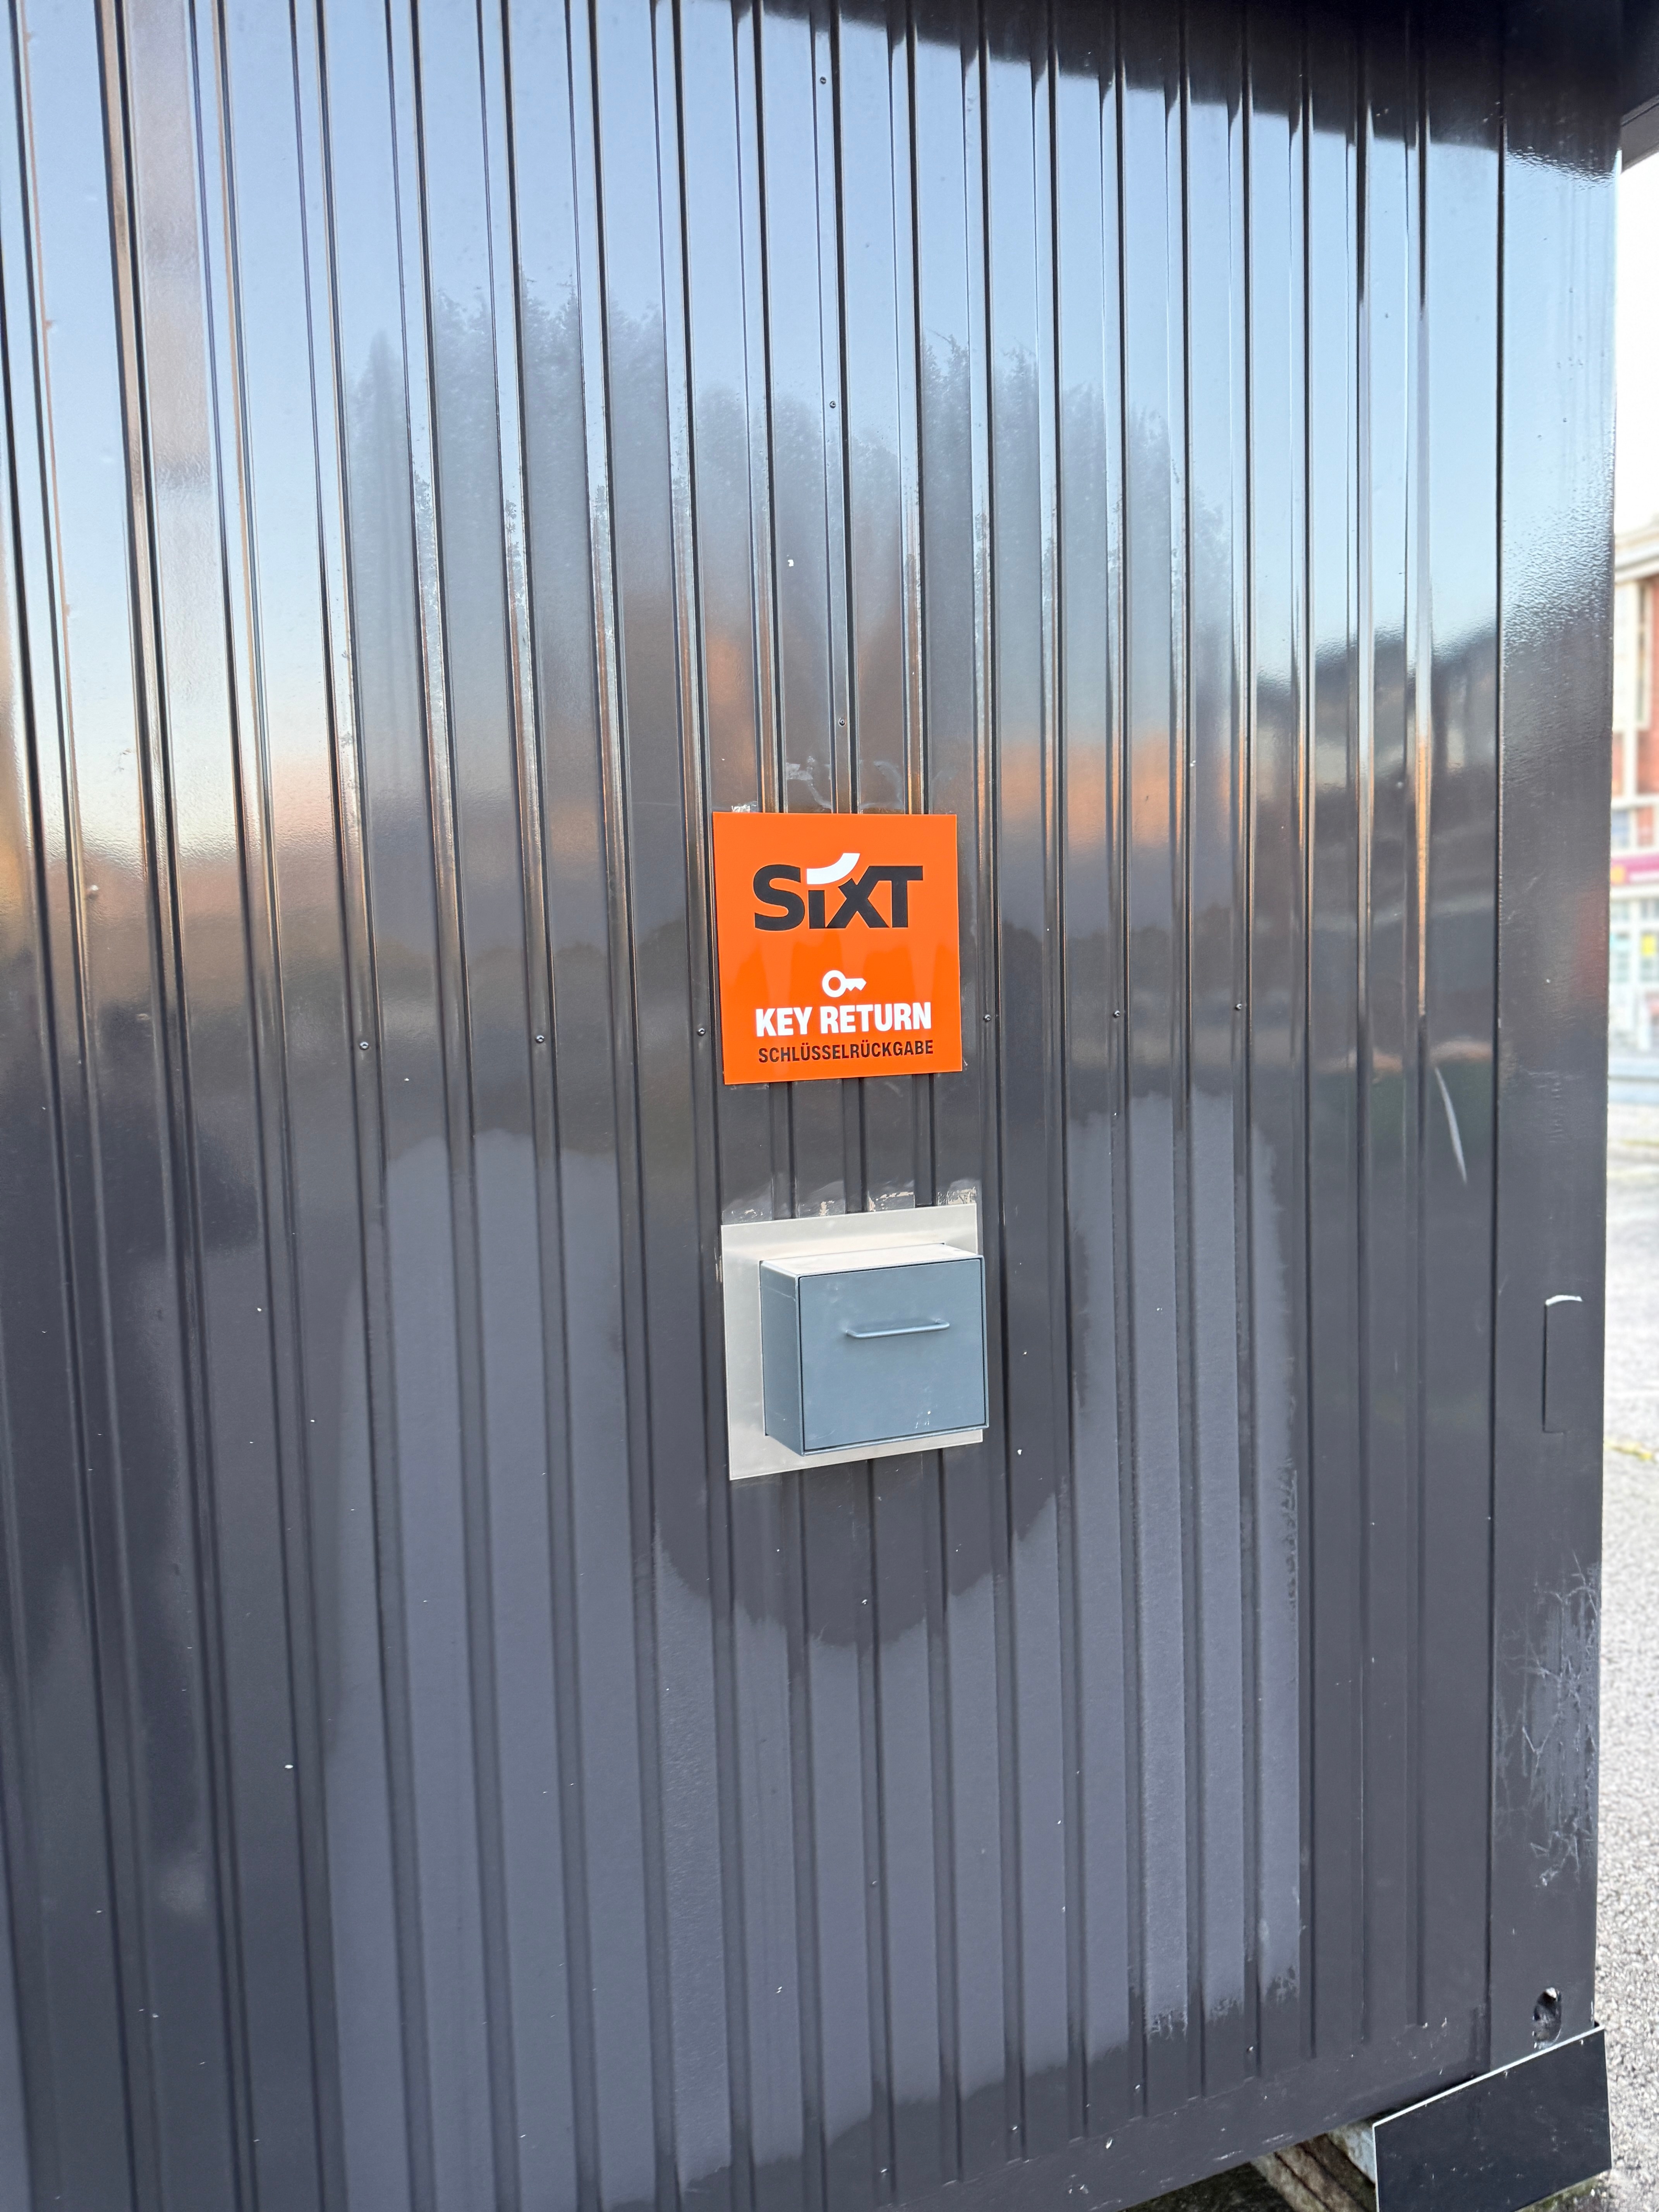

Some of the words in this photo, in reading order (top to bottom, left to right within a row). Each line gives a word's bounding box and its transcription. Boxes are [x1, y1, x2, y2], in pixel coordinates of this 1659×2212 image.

[756, 1006, 812, 1037] KEY
[820, 1002, 932, 1034] RETURN
[758, 1039, 933, 1063] SCHLÜSSELRÜCKGABE
